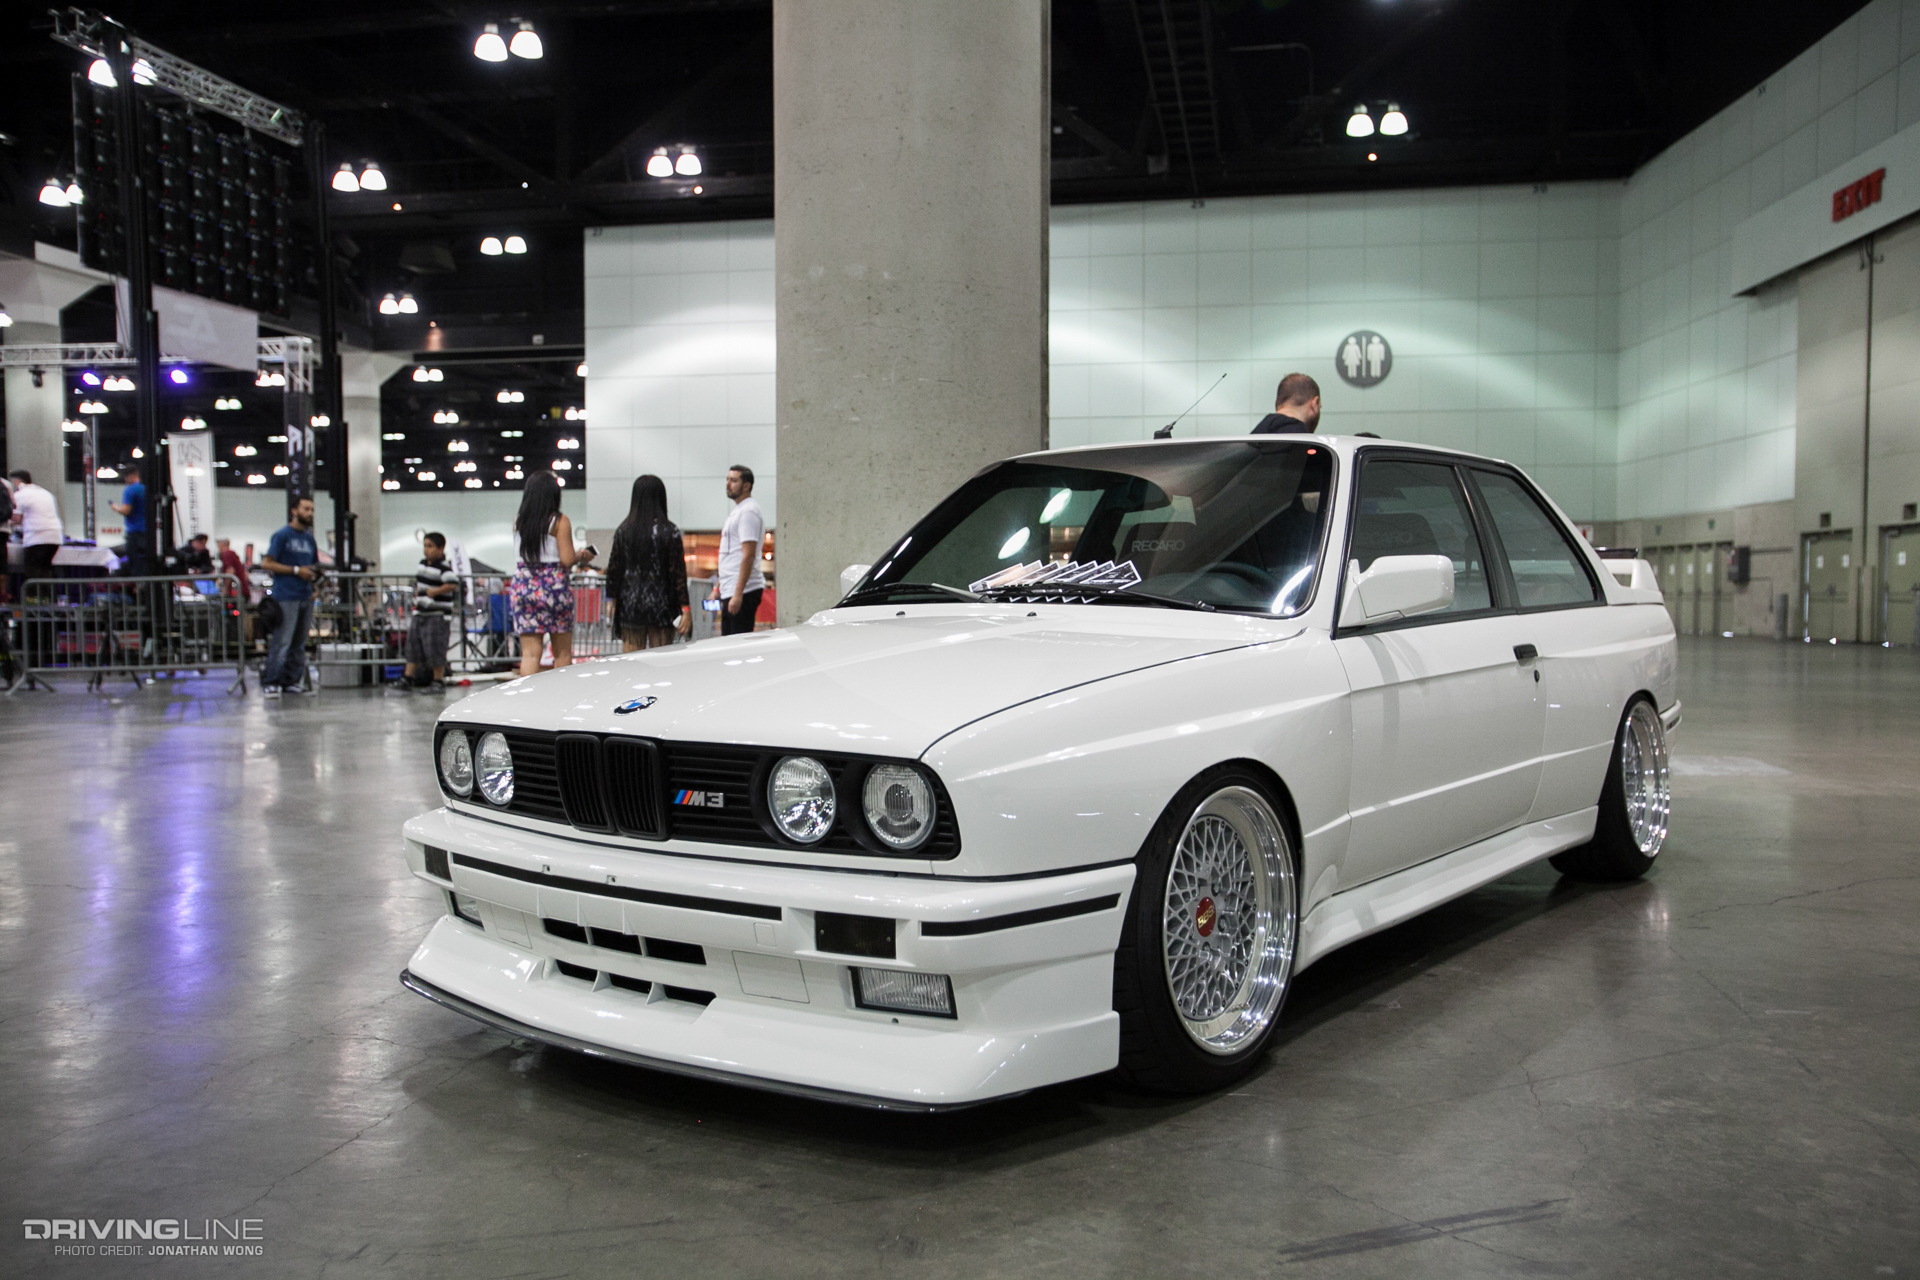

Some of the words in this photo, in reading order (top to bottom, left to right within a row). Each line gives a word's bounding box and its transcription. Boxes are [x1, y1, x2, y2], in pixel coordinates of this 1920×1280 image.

[1832, 167, 1886, 223] EXIT
[1132, 540, 1185, 552] RECARO
[687, 790, 724, 808] M3
[1197, 904, 1215, 929] BBS
